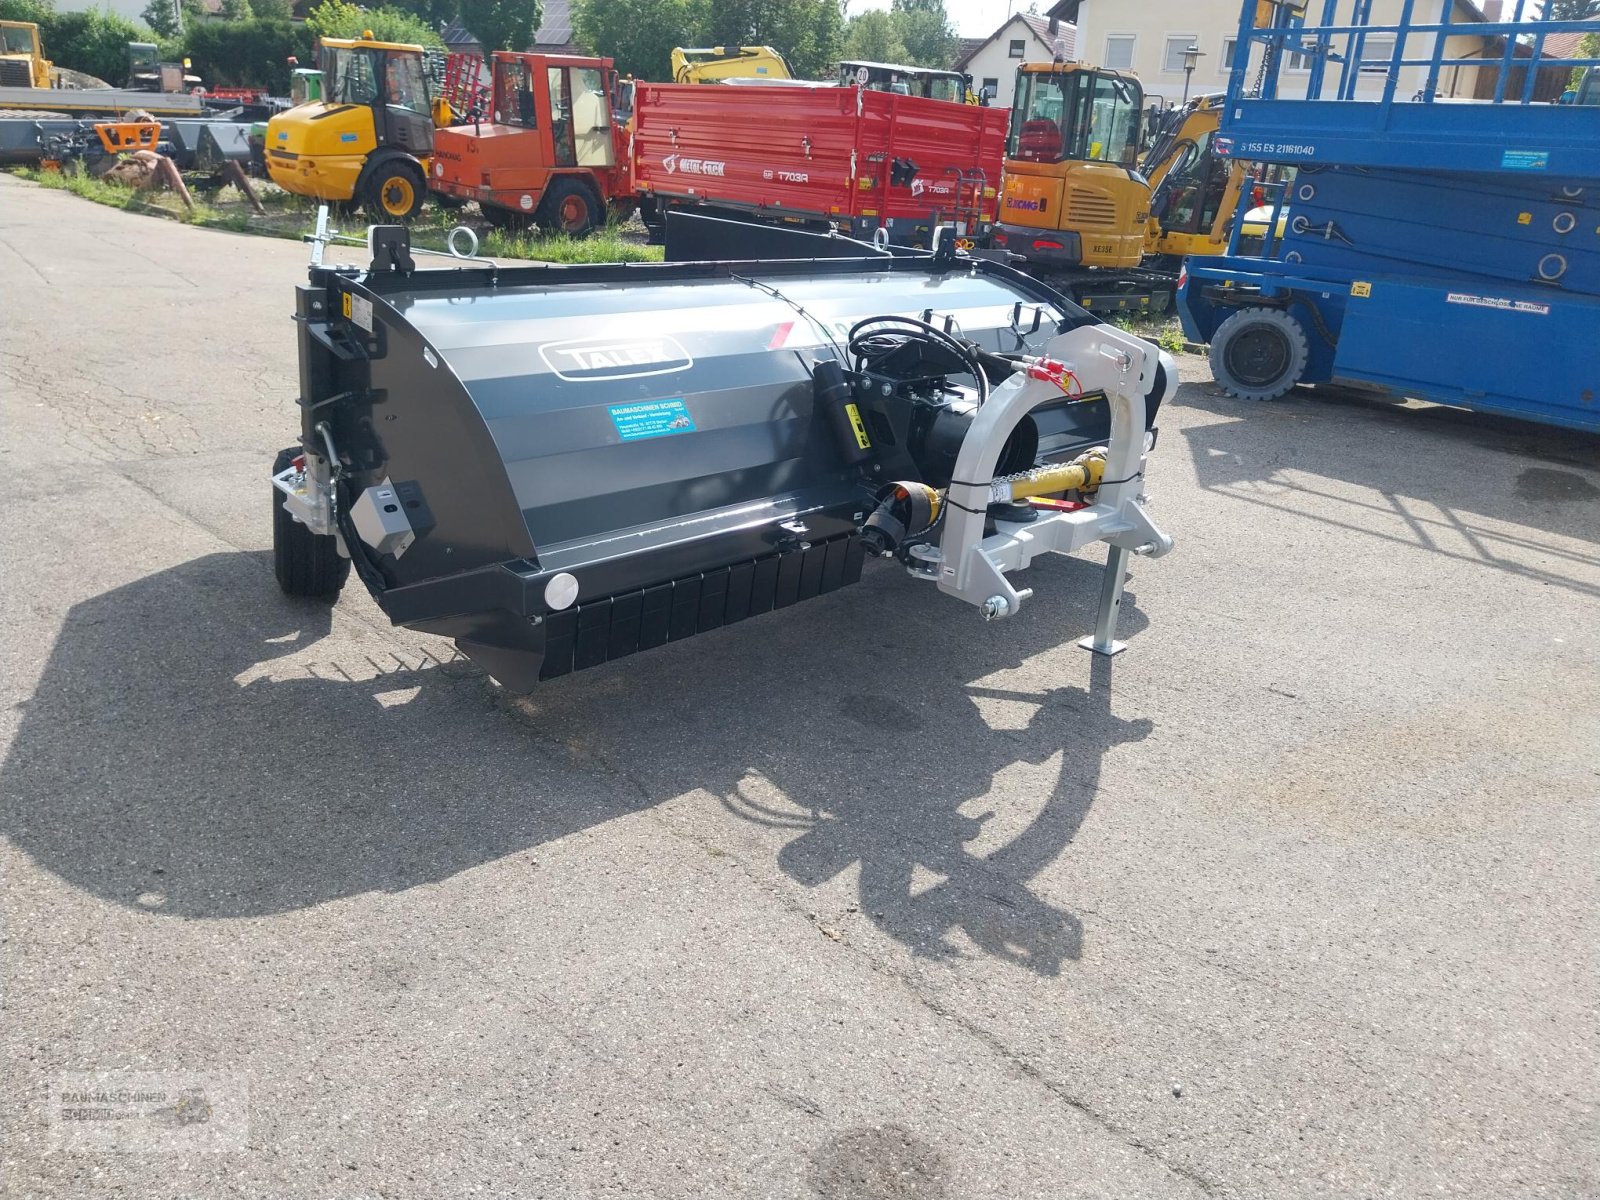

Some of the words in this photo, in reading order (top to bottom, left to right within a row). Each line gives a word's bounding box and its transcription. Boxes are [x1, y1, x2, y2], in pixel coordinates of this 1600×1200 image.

[859, 69, 868, 81] 20
[1240, 143, 1247, 151] S
[1248, 143, 1262, 152] 155
[1263, 143, 1275, 153] ES
[1276, 144, 1315, 155] 21161040
[1012, 199, 1038, 211] XCMG
[1093, 241, 1113, 254] XE35E
[555, 341, 674, 370] TALEX
[611, 403, 660, 416] BAUMASCHINEN
[660, 401, 682, 409] SCHMID
